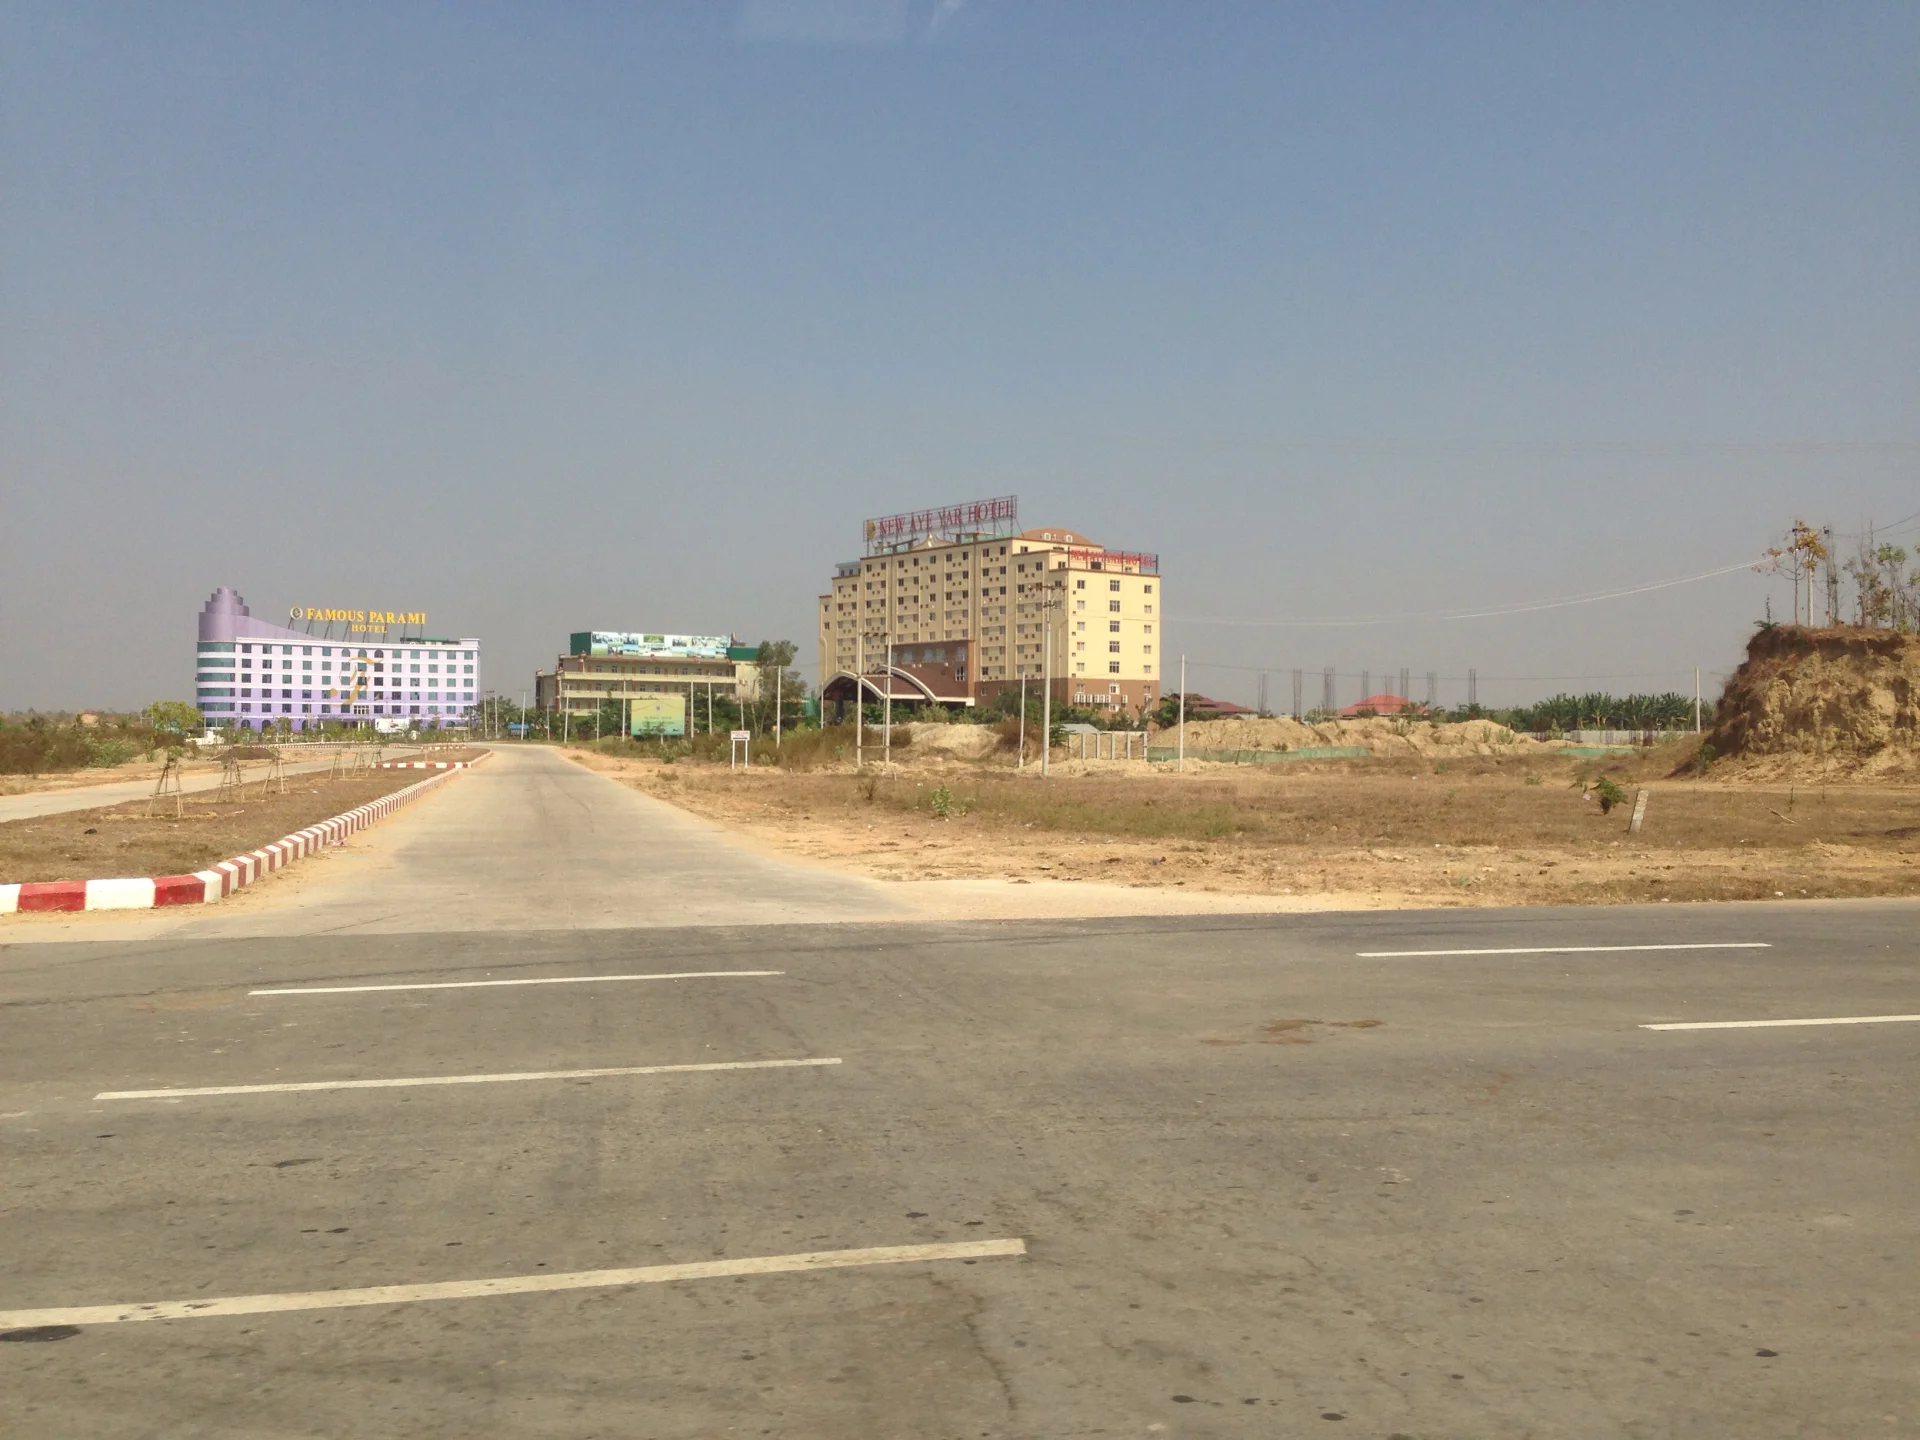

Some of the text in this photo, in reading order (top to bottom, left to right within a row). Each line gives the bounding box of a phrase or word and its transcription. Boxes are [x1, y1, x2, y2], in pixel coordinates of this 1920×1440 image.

[879, 500, 1015, 536] NEW AYE YAR HOTEL
[306, 608, 426, 624] FAMOUS PARAMI
[351, 624, 388, 634] HOTEL
